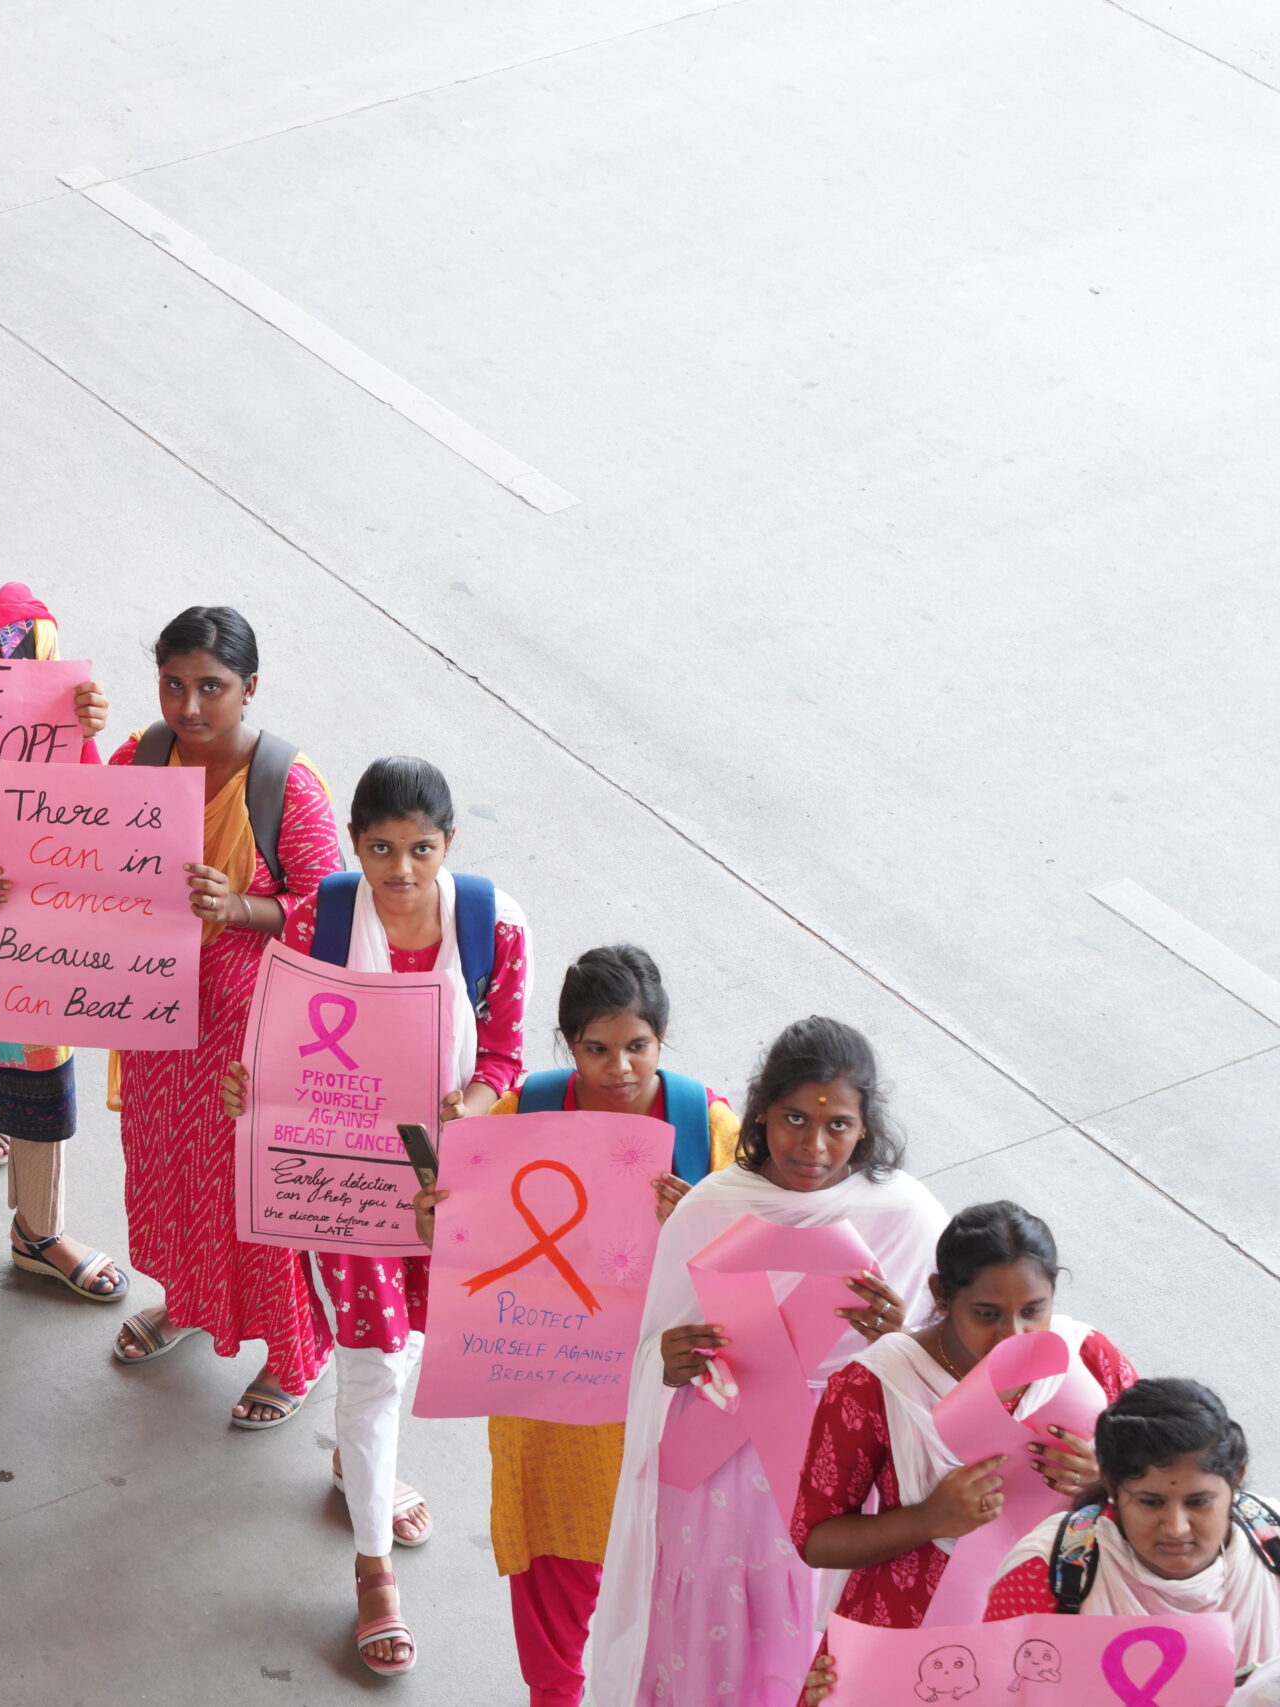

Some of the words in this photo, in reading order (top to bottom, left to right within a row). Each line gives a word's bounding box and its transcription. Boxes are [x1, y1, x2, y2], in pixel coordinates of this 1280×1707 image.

[4, 789, 110, 825] There
[125, 801, 162, 829] is
[29, 836, 103, 871] Can
[119, 848, 162, 875] in
[30, 882, 153, 916] Cancer
[128, 954, 177, 977] we
[4, 985, 52, 1016] Can
[64, 987, 133, 1020] Beat
[142, 1000, 180, 1024] it
[302, 1069, 383, 1093] PROTECT
[294, 1087, 387, 1112] YOURSELF
[308, 1107, 380, 1130] AGAINST
[274, 1124, 336, 1147] BREAST
[271, 1158, 336, 1203] Early
[340, 1172, 398, 1193] detection
[276, 1190, 301, 1200] can
[318, 1189, 352, 1207] help
[359, 1199, 388, 1213] you
[264, 1206, 283, 1219] the
[289, 1210, 329, 1222] disease
[374, 1220, 387, 1228] it
[391, 1220, 400, 1229] is
[314, 1224, 354, 1237] LATE
[497, 1290, 589, 1330] PROTECT
[462, 1332, 548, 1356] YOURSELF
[554, 1344, 625, 1362] AGAINST
[488, 1363, 558, 1383] BREAST
[562, 1370, 622, 1385] CANCER
